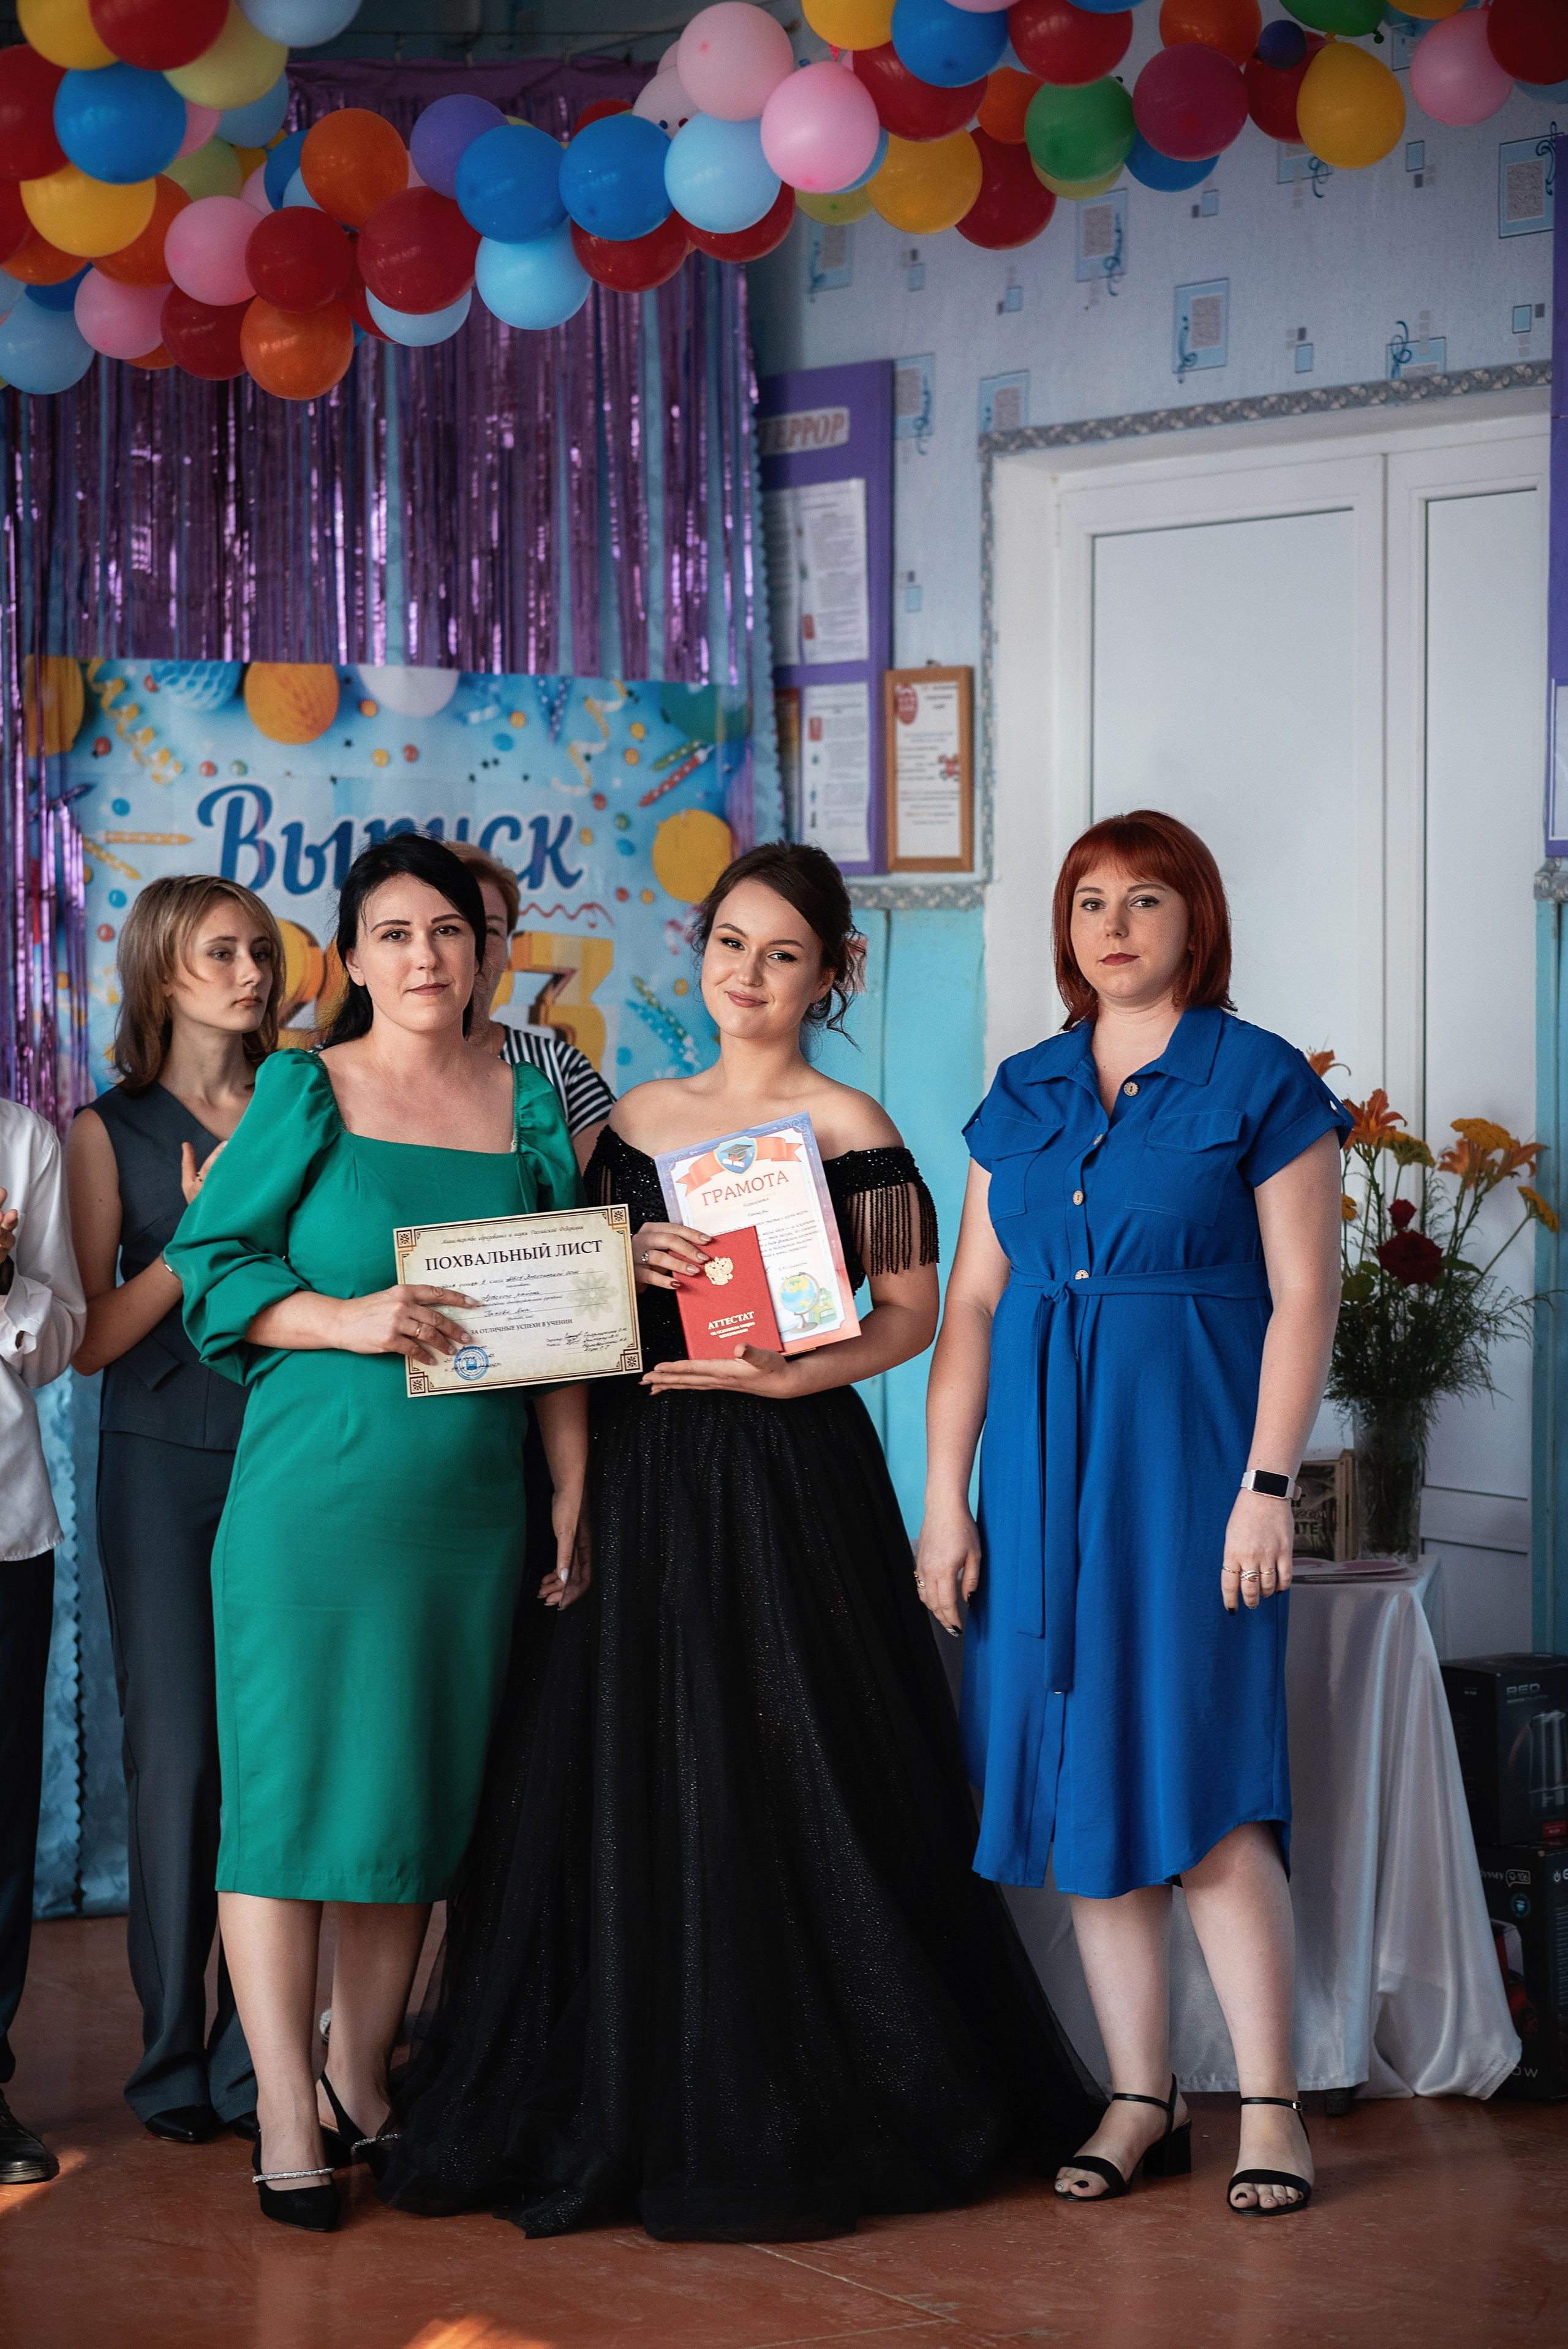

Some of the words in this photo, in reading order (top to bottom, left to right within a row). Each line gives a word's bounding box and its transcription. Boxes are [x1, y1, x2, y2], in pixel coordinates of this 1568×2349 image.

[703, 1171, 790, 1206] ГРАМОТА
[426, 1243, 551, 1271] ПОХВАЛЬНЫЙ
[556, 1240, 603, 1257] ЛИСТ
[516, 1322, 541, 1331] УСПЕХИ
[548, 1319, 573, 1328] УЧЕНИИ
[708, 1311, 754, 1330] АТТЕСТАТ
